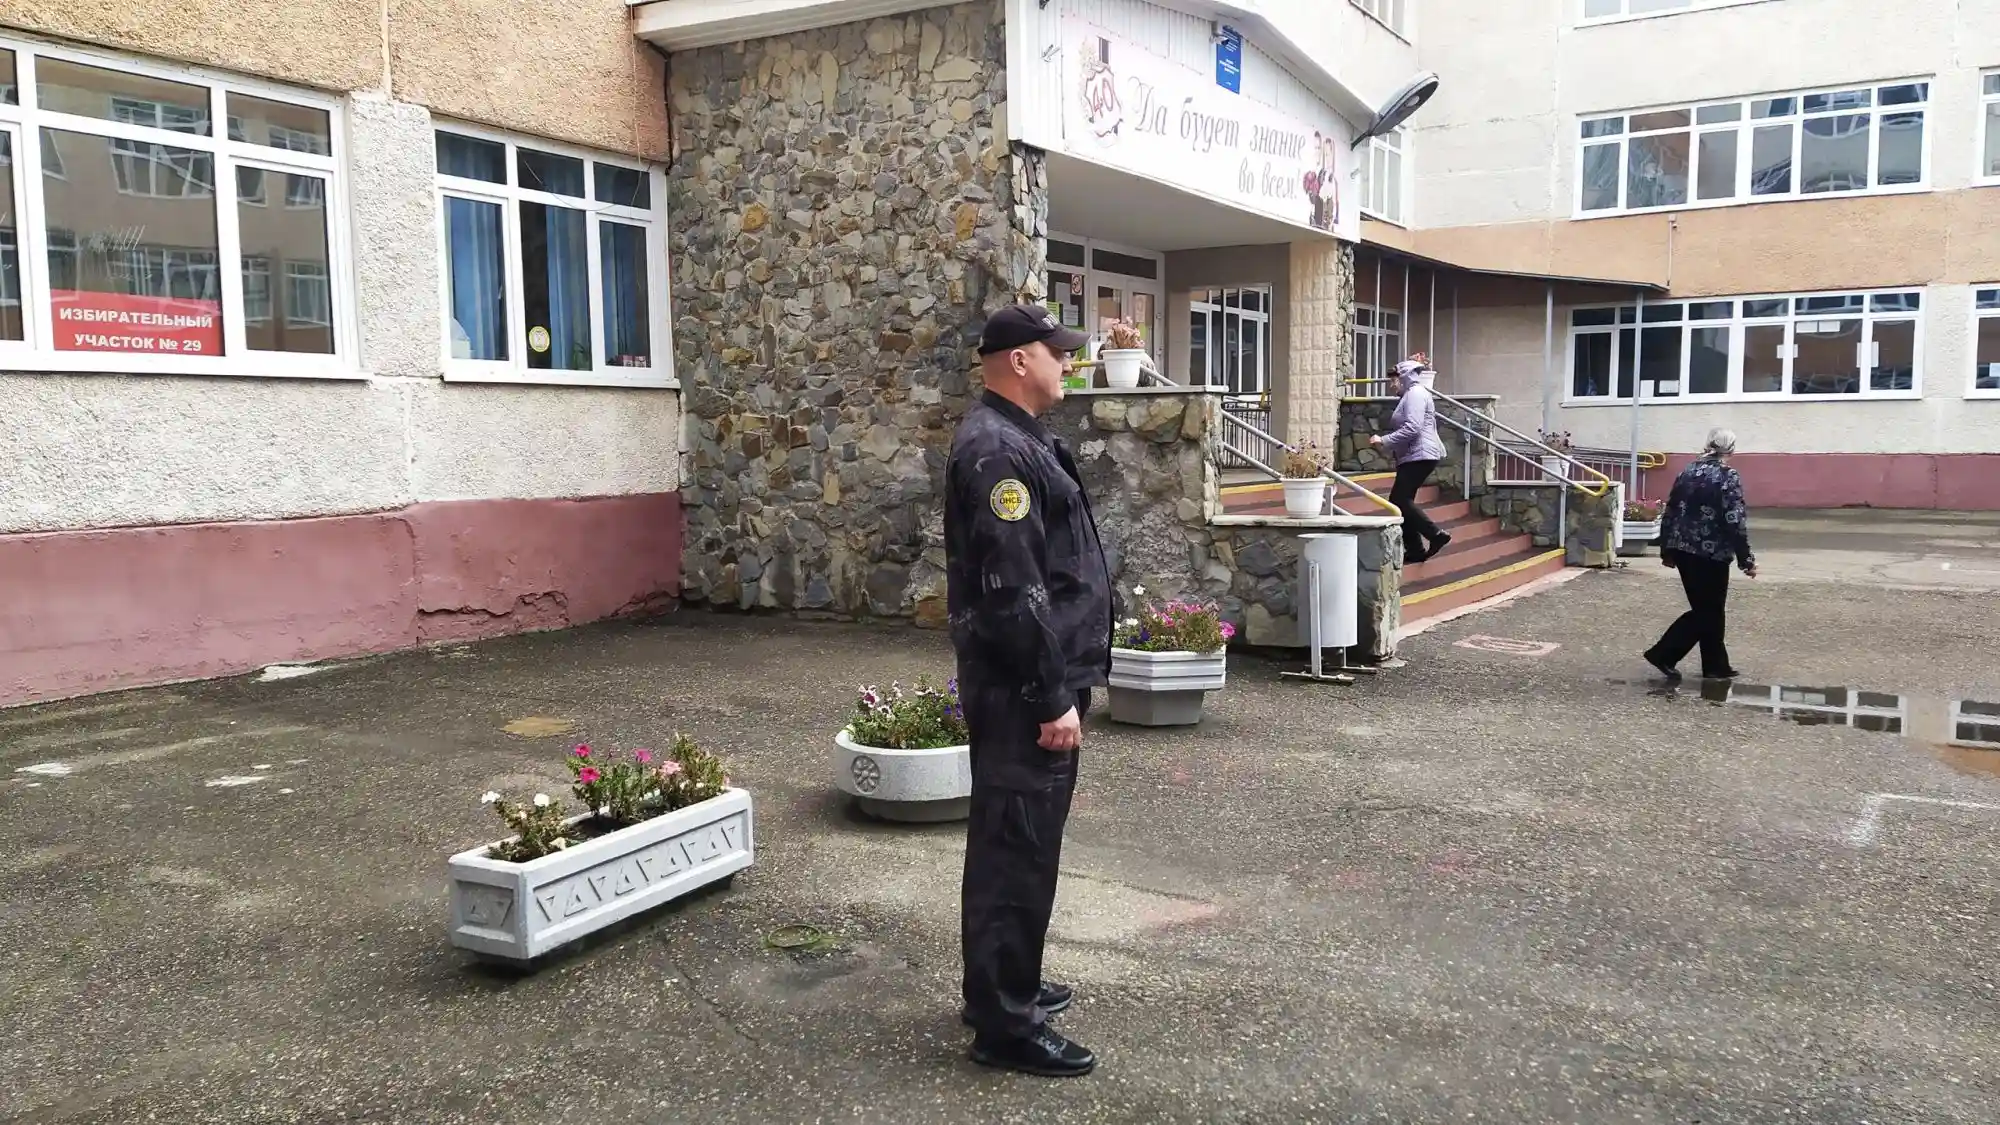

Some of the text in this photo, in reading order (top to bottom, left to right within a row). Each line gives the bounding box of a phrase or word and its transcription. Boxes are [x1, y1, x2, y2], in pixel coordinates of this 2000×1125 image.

[1180, 97, 1240, 153] будет
[1250, 124, 1306, 160] знание
[1239, 157, 1255, 194] во
[59, 307, 213, 328] ИЗБИРАТЕЛЬНЫЙ
[74, 333, 202, 351] УЧАСТОК № 29
